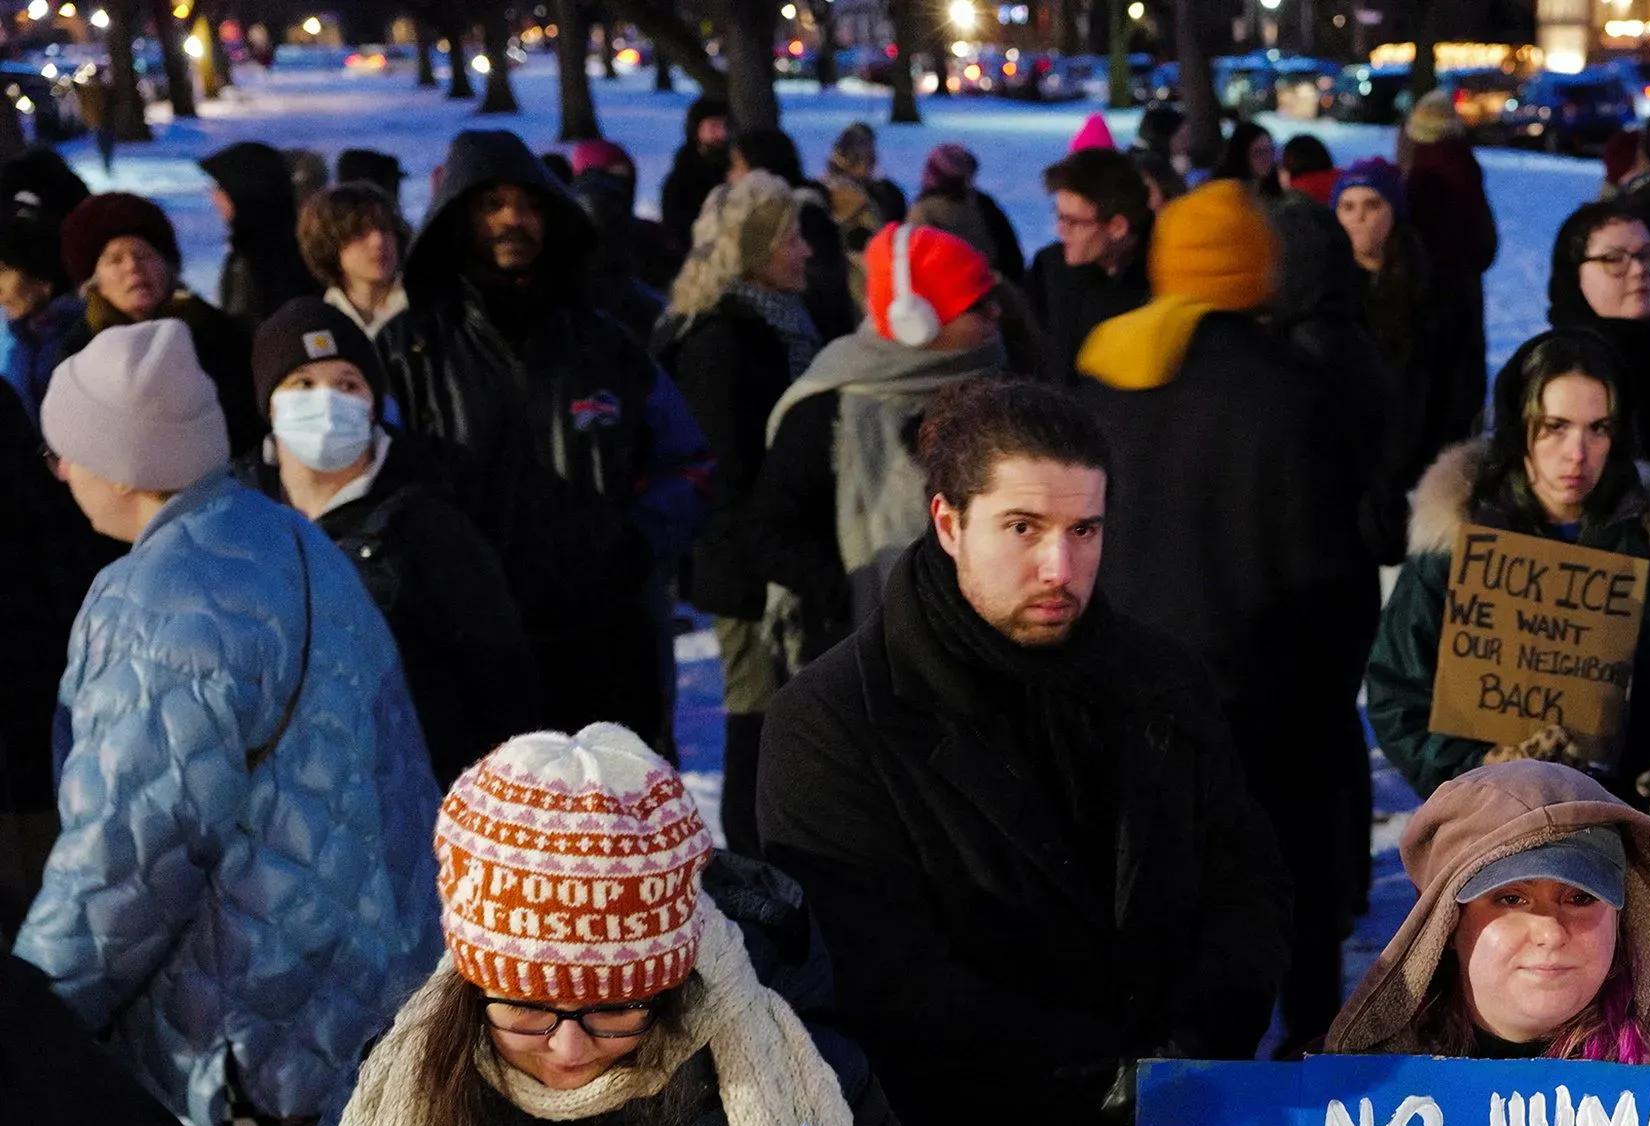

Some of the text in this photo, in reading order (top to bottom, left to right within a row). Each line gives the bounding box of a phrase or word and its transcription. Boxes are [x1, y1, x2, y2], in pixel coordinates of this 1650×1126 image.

[1458, 534, 1636, 617] FUCK ICE
[1450, 589, 1590, 645] WE WANT
[1453, 631, 1502, 666] OUR
[1478, 673, 1564, 726] BACK
[489, 866, 685, 910] POOP ON
[483, 895, 690, 943] FASCISTS
